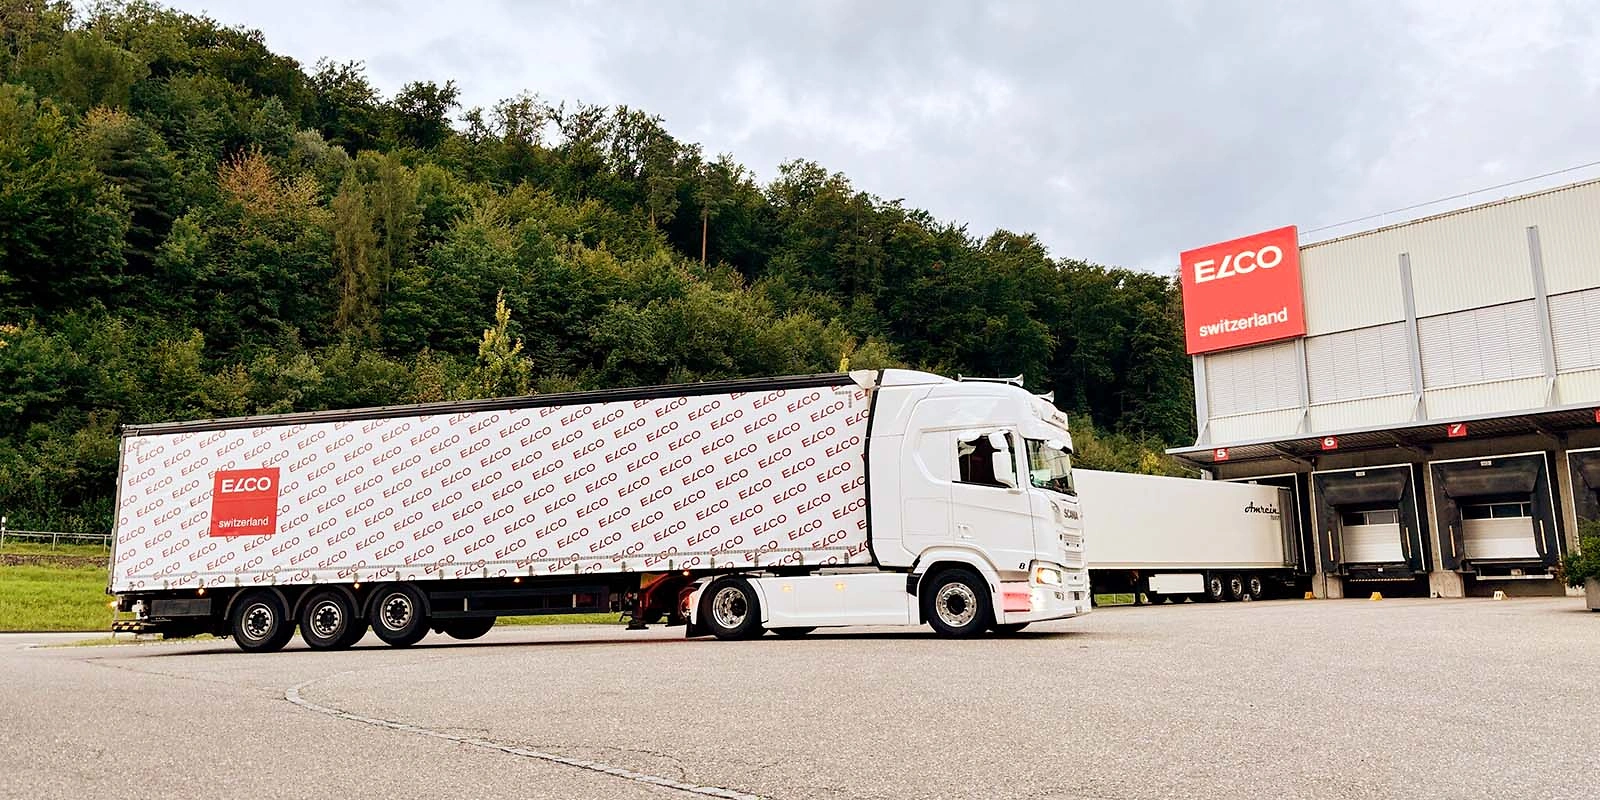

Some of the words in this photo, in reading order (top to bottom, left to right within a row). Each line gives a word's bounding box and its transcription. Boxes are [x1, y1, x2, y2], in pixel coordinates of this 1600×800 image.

[1194, 246, 1282, 284] ELCO
[1199, 307, 1288, 337] switzerland
[654, 397, 688, 418] ELCO
[752, 389, 787, 409] ELCO
[787, 392, 820, 413] ELCO
[561, 406, 592, 426] ELCO
[592, 409, 624, 430] ELCO
[688, 400, 720, 421] ELCO
[710, 409, 743, 430] ELCO
[810, 401, 844, 422] ELCO
[382, 423, 410, 442] ELCO
[469, 415, 499, 435] ELCO
[499, 418, 530, 438] ELCO
[614, 418, 646, 439] ELCO
[646, 421, 678, 442] ELCO
[744, 413, 777, 434] ELCO
[767, 423, 800, 443] ELCO
[1451, 424, 1463, 434] 7
[198, 430, 226, 448] ELCO
[298, 431, 325, 450] ELCO
[326, 434, 353, 453] ELCO
[410, 426, 440, 446] ELCO
[430, 435, 460, 454] ELCO
[520, 427, 551, 447] ELCO
[552, 430, 583, 450] ELCO
[668, 430, 701, 451] ELCO
[701, 434, 734, 455] ELCO
[801, 427, 835, 447] ELCO
[1324, 437, 1335, 447] 6
[137, 446, 164, 464] ELCO
[217, 439, 244, 457] ELCO
[244, 442, 271, 460] ELCO
[344, 443, 372, 462] ELCO
[373, 447, 401, 466] ELCO
[460, 438, 490, 458] ELCO
[573, 439, 604, 460] ELCO
[605, 443, 637, 463] ELCO
[724, 444, 757, 464] ELCO
[825, 436, 859, 457] ELCO
[1217, 449, 1225, 458] 5
[164, 449, 190, 468] ELCO
[181, 457, 208, 476] ELCO
[261, 450, 289, 468] ELCO
[289, 454, 317, 472] ELCO
[392, 455, 421, 475] ELCO
[480, 447, 511, 467] ELCO
[512, 451, 542, 471] ELCO
[627, 452, 659, 472] ELCO
[659, 456, 692, 476] ELCO
[758, 448, 791, 469] ELCO
[128, 468, 155, 486] ELCO
[307, 463, 335, 481] ELCO
[336, 466, 364, 485] ELCO
[421, 459, 451, 479] ELCO
[441, 467, 471, 487] ELCO
[532, 460, 564, 480] ELCO
[564, 464, 595, 484] ELCO
[682, 465, 714, 486] ELCO
[781, 457, 815, 478] ELCO
[817, 462, 851, 483] ELCO
[145, 477, 172, 495] ELCO
[172, 480, 199, 499] ELCO
[222, 476, 271, 493] ELCO
[354, 475, 383, 494] ELCO
[383, 479, 412, 498] ELCO
[472, 471, 502, 491] ELCO
[585, 473, 617, 493] ELCO
[618, 476, 650, 497] ELCO
[715, 469, 748, 490] ELCO
[738, 479, 772, 500] ELCO
[299, 485, 326, 504] ELCO
[402, 488, 432, 507] ELCO
[492, 480, 523, 501] ELCO
[523, 484, 555, 504] ELCO
[640, 486, 672, 507] ELCO
[673, 490, 705, 511] ELCO
[773, 483, 807, 504] ELCO
[136, 499, 163, 517] ELCO
[317, 494, 345, 514] ELCO
[345, 498, 374, 518] ELCO
[432, 491, 462, 511] ELCO
[452, 501, 483, 521] ELCO
[545, 493, 576, 514] ELCO
[576, 497, 608, 518] ELCO
[696, 500, 728, 520] ELCO
[797, 493, 831, 515] ELCO
[832, 496, 869, 519] ELCO
[154, 507, 181, 526] ELCO
[181, 511, 208, 530] ELCO
[218, 516, 269, 528] switzerland
[280, 514, 308, 533] ELCO
[364, 507, 393, 527] ELCO
[393, 512, 423, 531] ELCO
[483, 505, 514, 525] ELCO
[504, 514, 535, 534] ELCO
[598, 507, 630, 528] ELCO
[631, 511, 663, 532] ELCO
[730, 504, 763, 525] ELCO
[119, 526, 145, 544] ELCO
[308, 518, 336, 537] ELCO
[413, 521, 443, 541] ELCO
[443, 525, 474, 545] ELCO
[536, 518, 567, 539] ELCO
[653, 521, 686, 542] ELCO
[753, 514, 787, 536] ELCO
[788, 519, 822, 540] ELCO
[145, 530, 172, 548] ELCO
[327, 527, 355, 546] ELCO
[356, 531, 384, 551] ELCO
[464, 535, 495, 555] ELCO
[557, 528, 589, 549] ELCO
[589, 532, 621, 553] ELCO
[687, 525, 720, 546] ELCO
[811, 530, 848, 551] ELCO
[162, 539, 190, 557] ELCO
[189, 543, 216, 561] ELCO
[272, 537, 300, 556] ELCO
[290, 546, 318, 565] ELCO
[375, 541, 404, 560] ELCO
[404, 545, 436, 565] ELCO
[495, 539, 526, 559] ELCO
[708, 536, 744, 557] ELCO
[127, 558, 153, 577] ELCO
[207, 552, 235, 570] ELCO
[234, 556, 263, 575] ELCO
[317, 551, 348, 571] ELCO
[547, 553, 581, 573] ELCO
[152, 562, 181, 581] ELCO
[251, 565, 282, 585] ELCO
